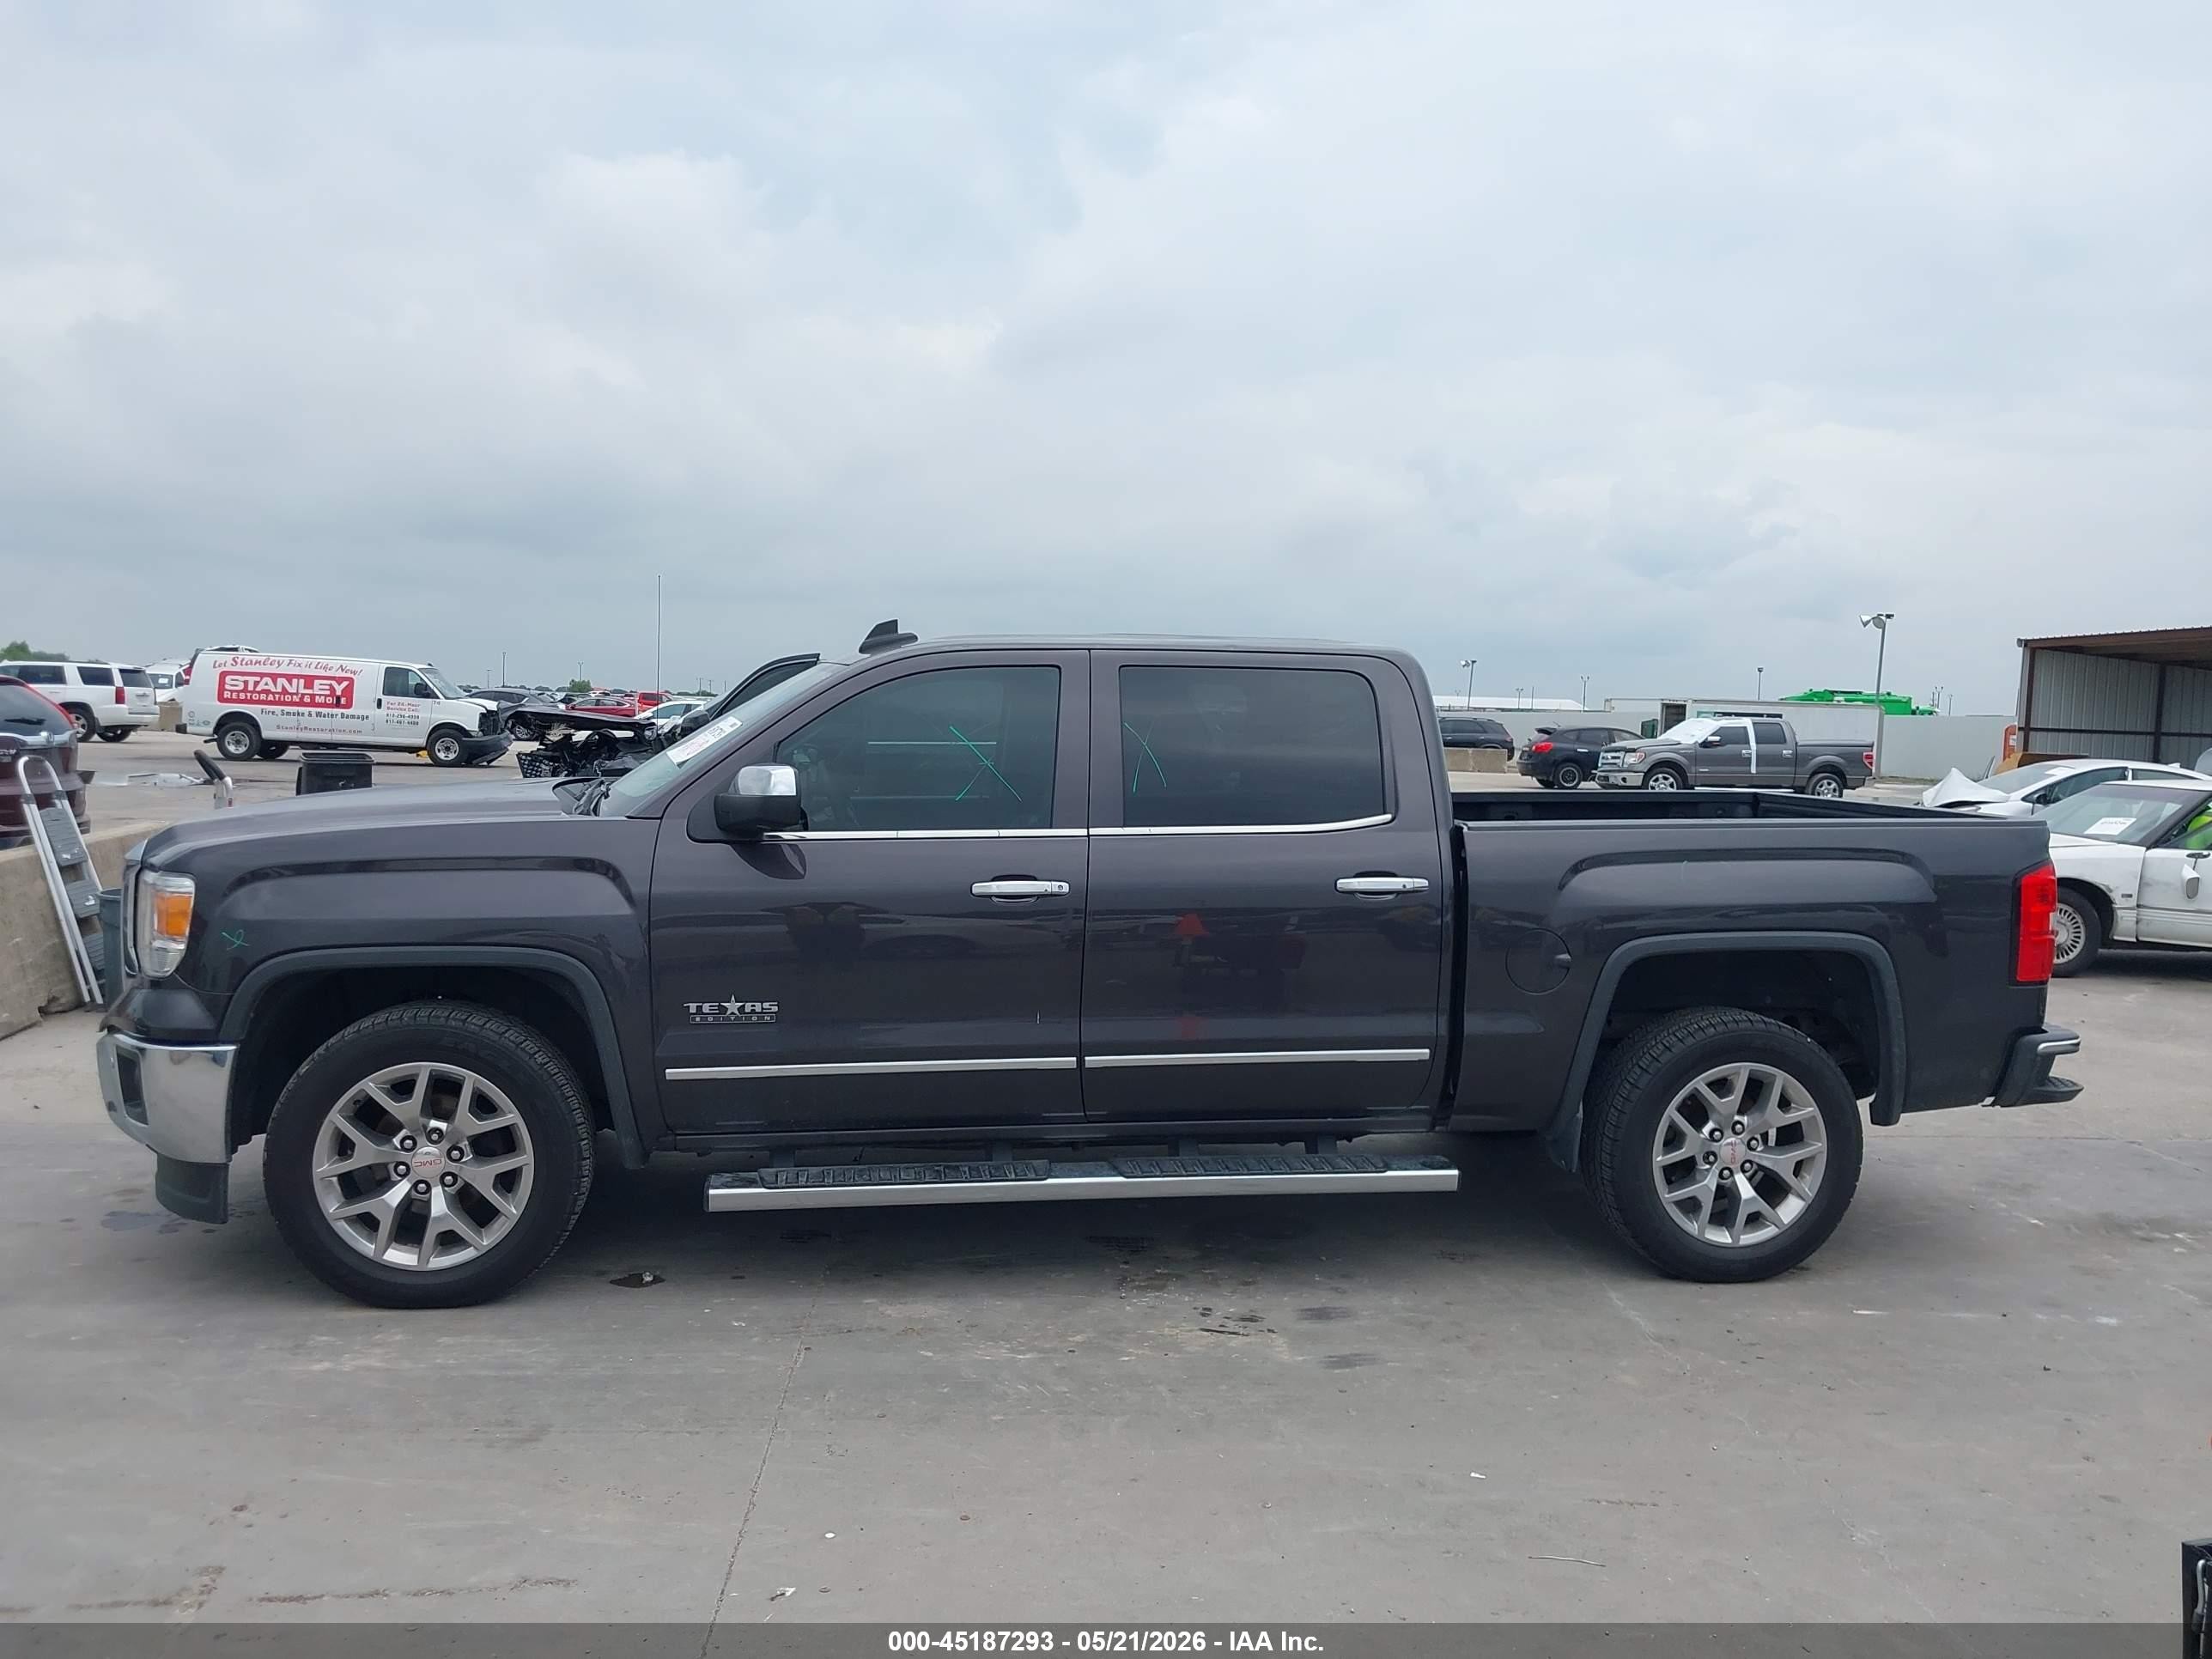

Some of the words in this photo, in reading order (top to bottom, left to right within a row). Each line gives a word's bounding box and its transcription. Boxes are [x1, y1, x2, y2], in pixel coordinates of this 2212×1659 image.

[213, 659, 228, 669] Let
[230, 656, 284, 669] Stanley
[287, 659, 303, 668] Fix
[314, 661, 334, 672] Like
[224, 675, 349, 696] STANLEY
[223, 690, 301, 702] RESTORATION
[303, 694, 311, 702] &
[260, 708, 279, 717] Fire,
[281, 708, 305, 718] Smoke
[315, 711, 339, 720] Water
[341, 712, 370, 721] Damage
[414, 1158, 441, 1168] GMC
